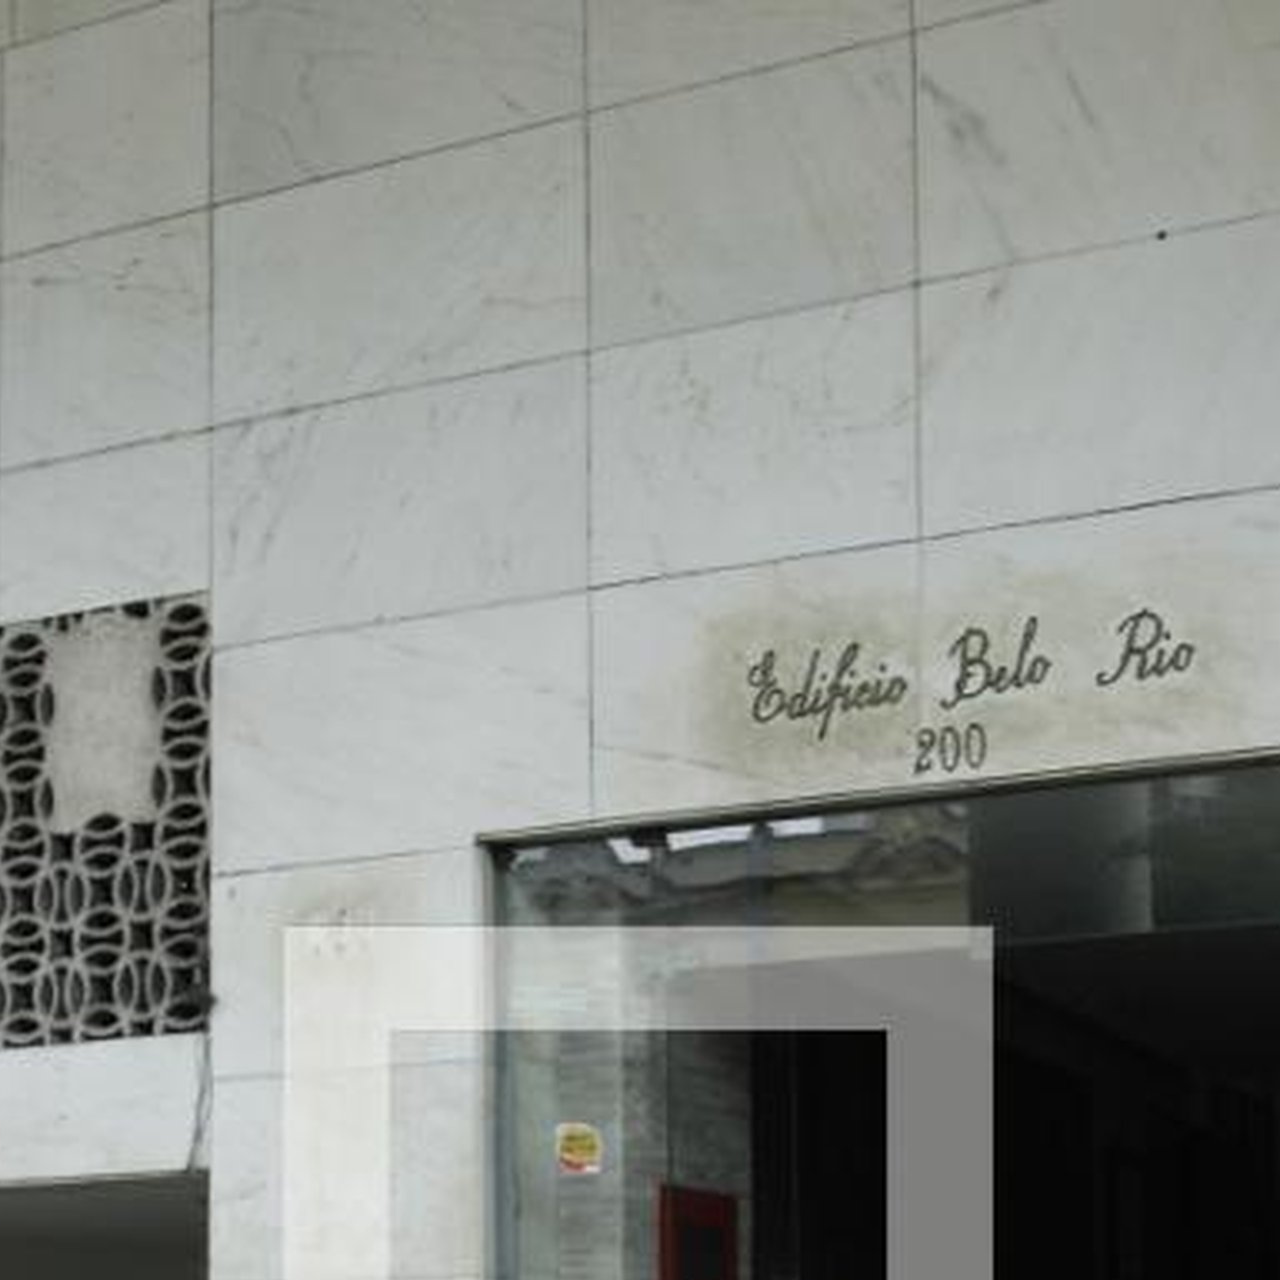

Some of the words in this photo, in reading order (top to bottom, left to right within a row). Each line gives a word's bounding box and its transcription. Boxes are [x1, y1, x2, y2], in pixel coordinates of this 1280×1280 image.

[747, 641, 908, 740] Edificio
[939, 615, 1052, 710] Belo
[1095, 607, 1195, 687] Rio
[913, 721, 988, 775] 200
